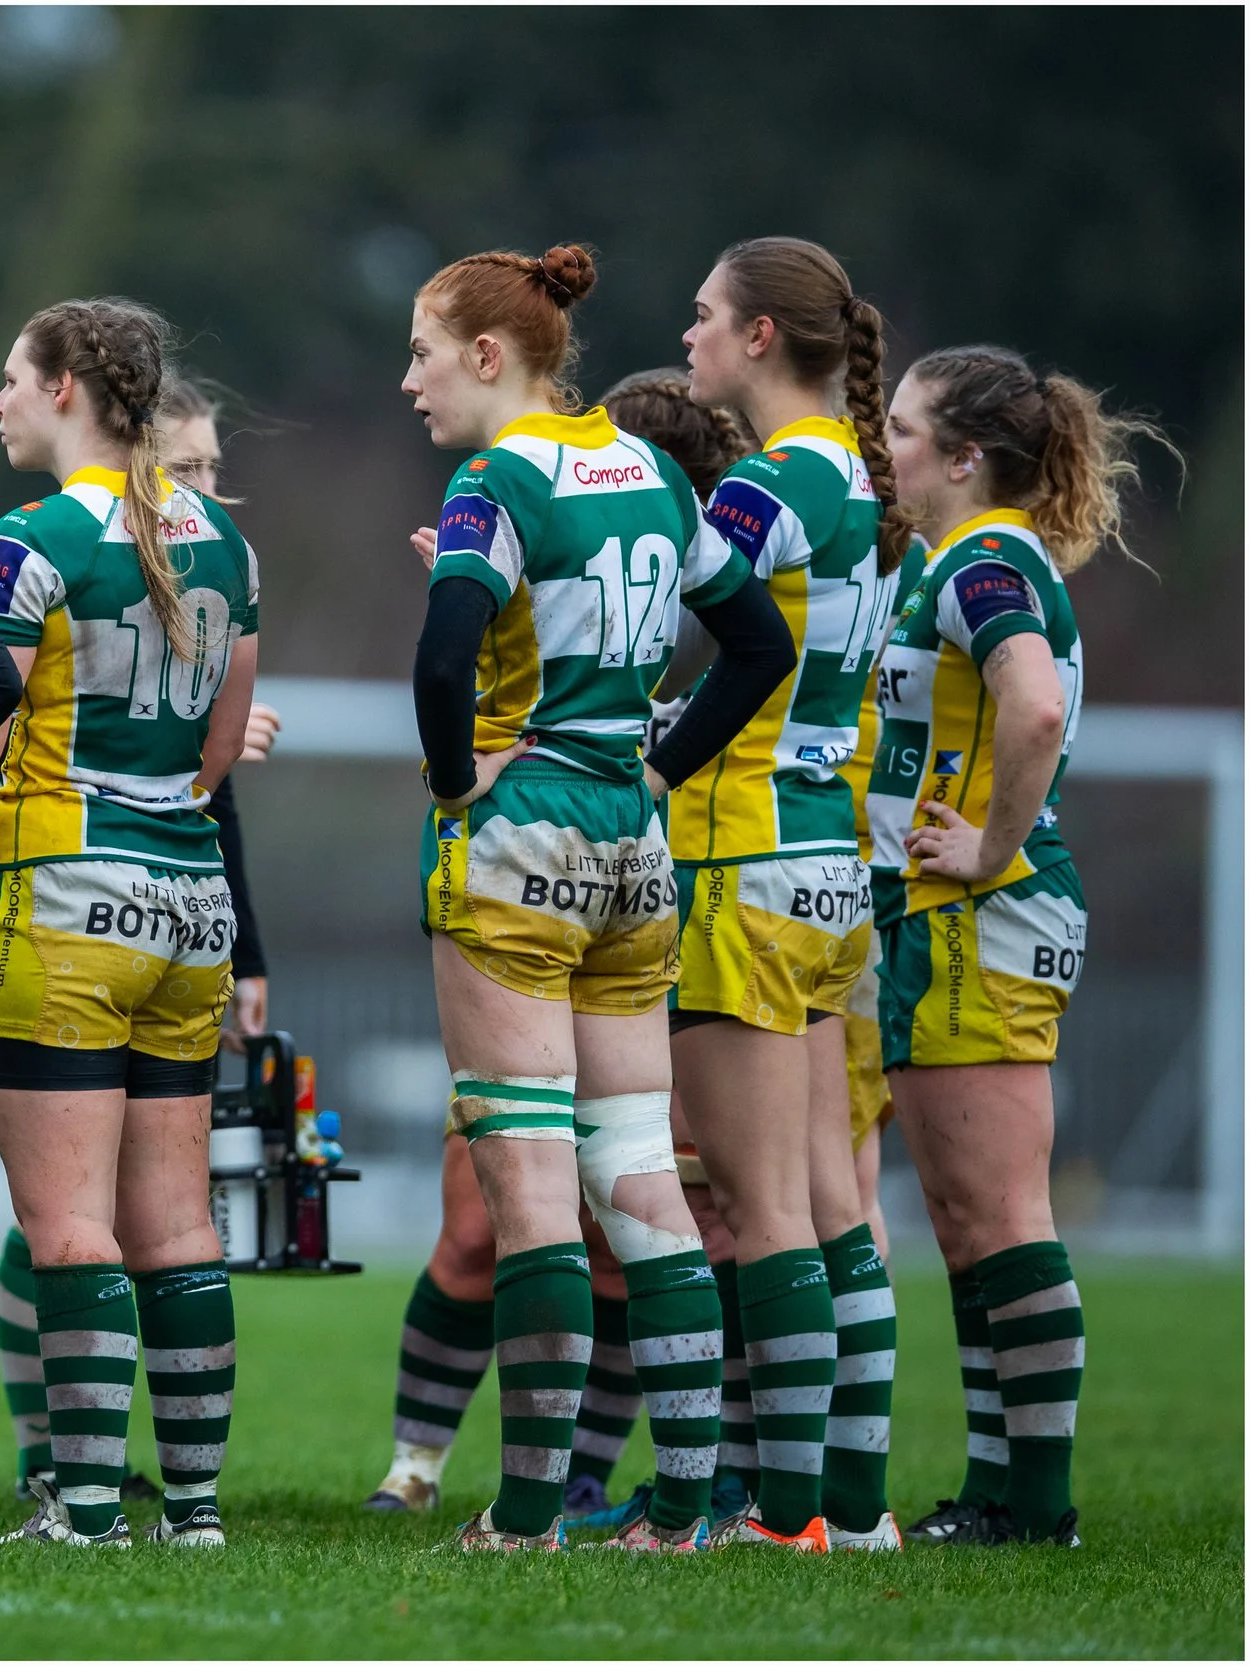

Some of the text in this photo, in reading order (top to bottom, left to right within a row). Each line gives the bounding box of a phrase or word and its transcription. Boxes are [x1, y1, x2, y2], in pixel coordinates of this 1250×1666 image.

[574, 461, 644, 488] Compra
[442, 513, 486, 530] SPRING
[713, 503, 761, 533] SPRING
[733, 526, 755, 542] Insure
[585, 534, 678, 668] 12
[120, 588, 230, 720] 10
[133, 882, 178, 905] LITTL
[439, 841, 453, 932] MOOREMen
[521, 875, 661, 917] BOTTMS
[704, 867, 725, 962] OREMent
[945, 914, 964, 1037] MOOREMentum
[193, 1513, 220, 1523] adida
